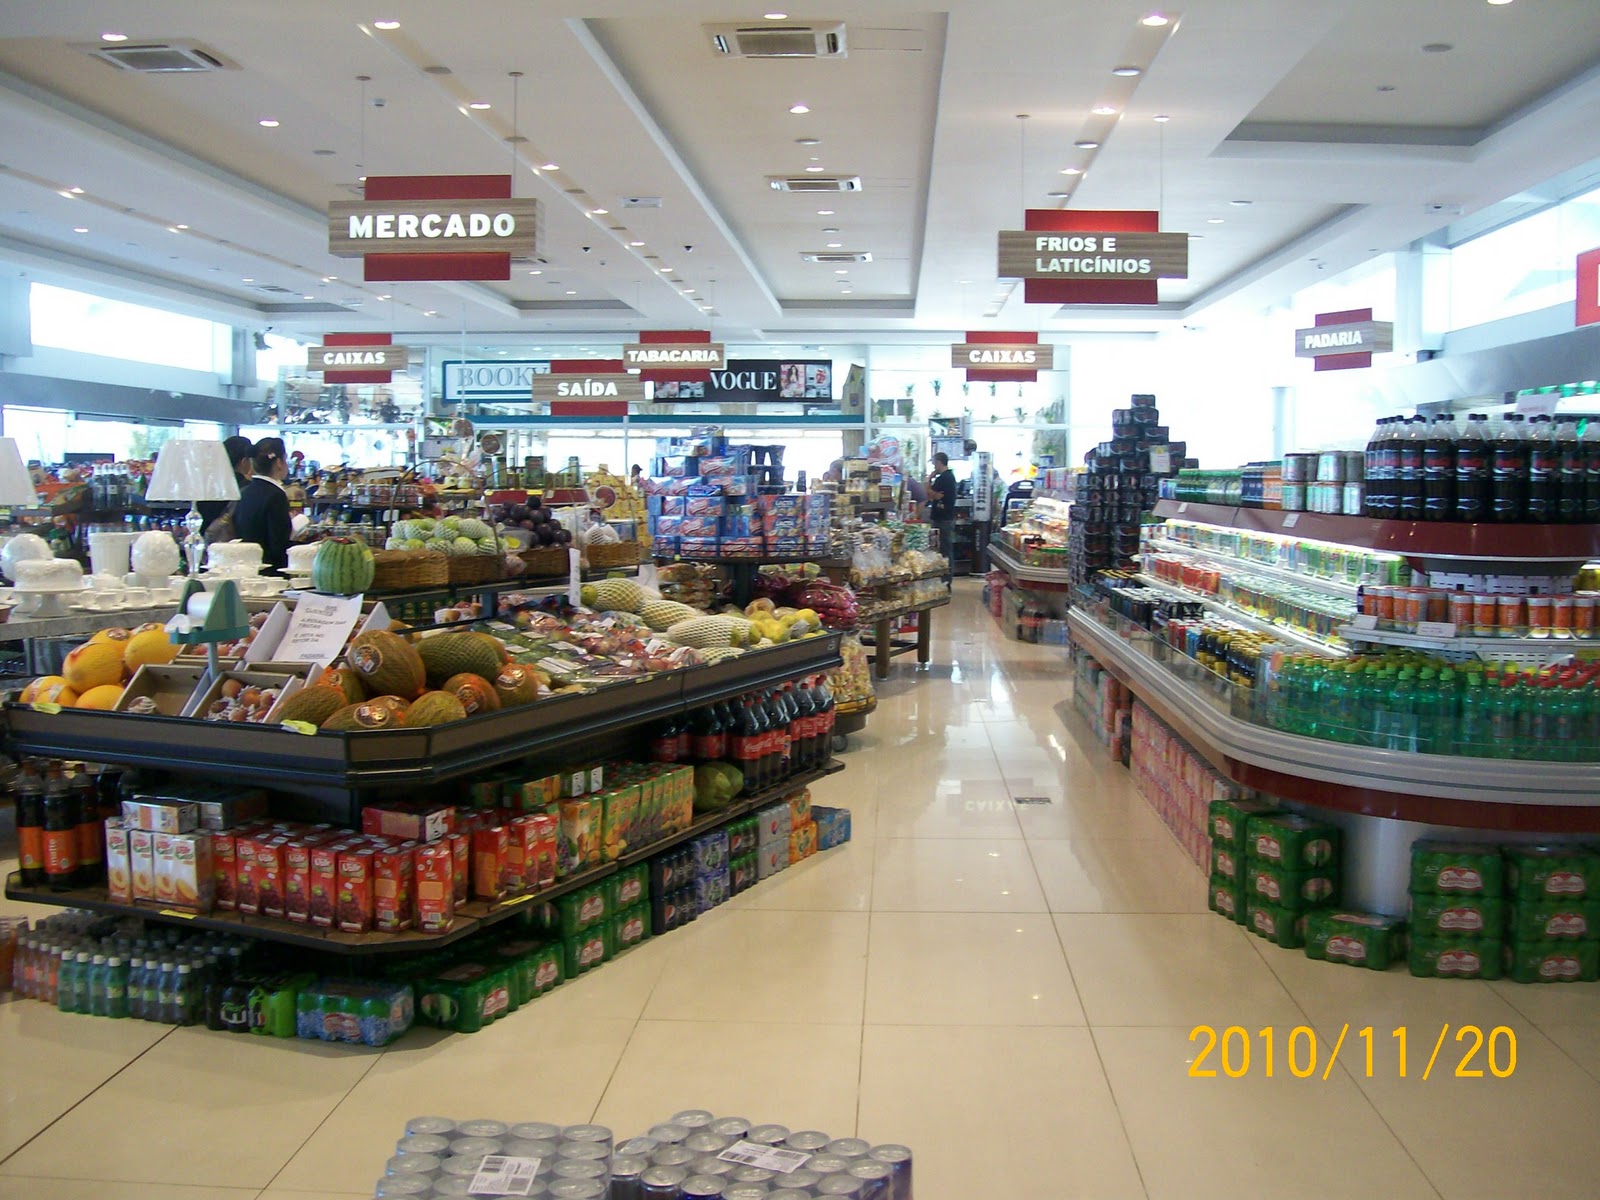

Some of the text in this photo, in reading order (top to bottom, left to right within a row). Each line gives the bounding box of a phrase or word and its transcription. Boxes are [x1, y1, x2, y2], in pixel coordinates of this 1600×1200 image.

[349, 213, 516, 239] MERCADO
[1036, 237, 1116, 252] FRIOS E
[1036, 256, 1151, 273] LATICÍNIOS
[1304, 330, 1363, 350] PADARIA
[323, 352, 386, 365] CAIXAS
[627, 350, 719, 363] TABACARIA
[969, 350, 1036, 363] CAIXAS
[557, 379, 619, 397] SAÍDA
[710, 371, 777, 391] VOGUE
